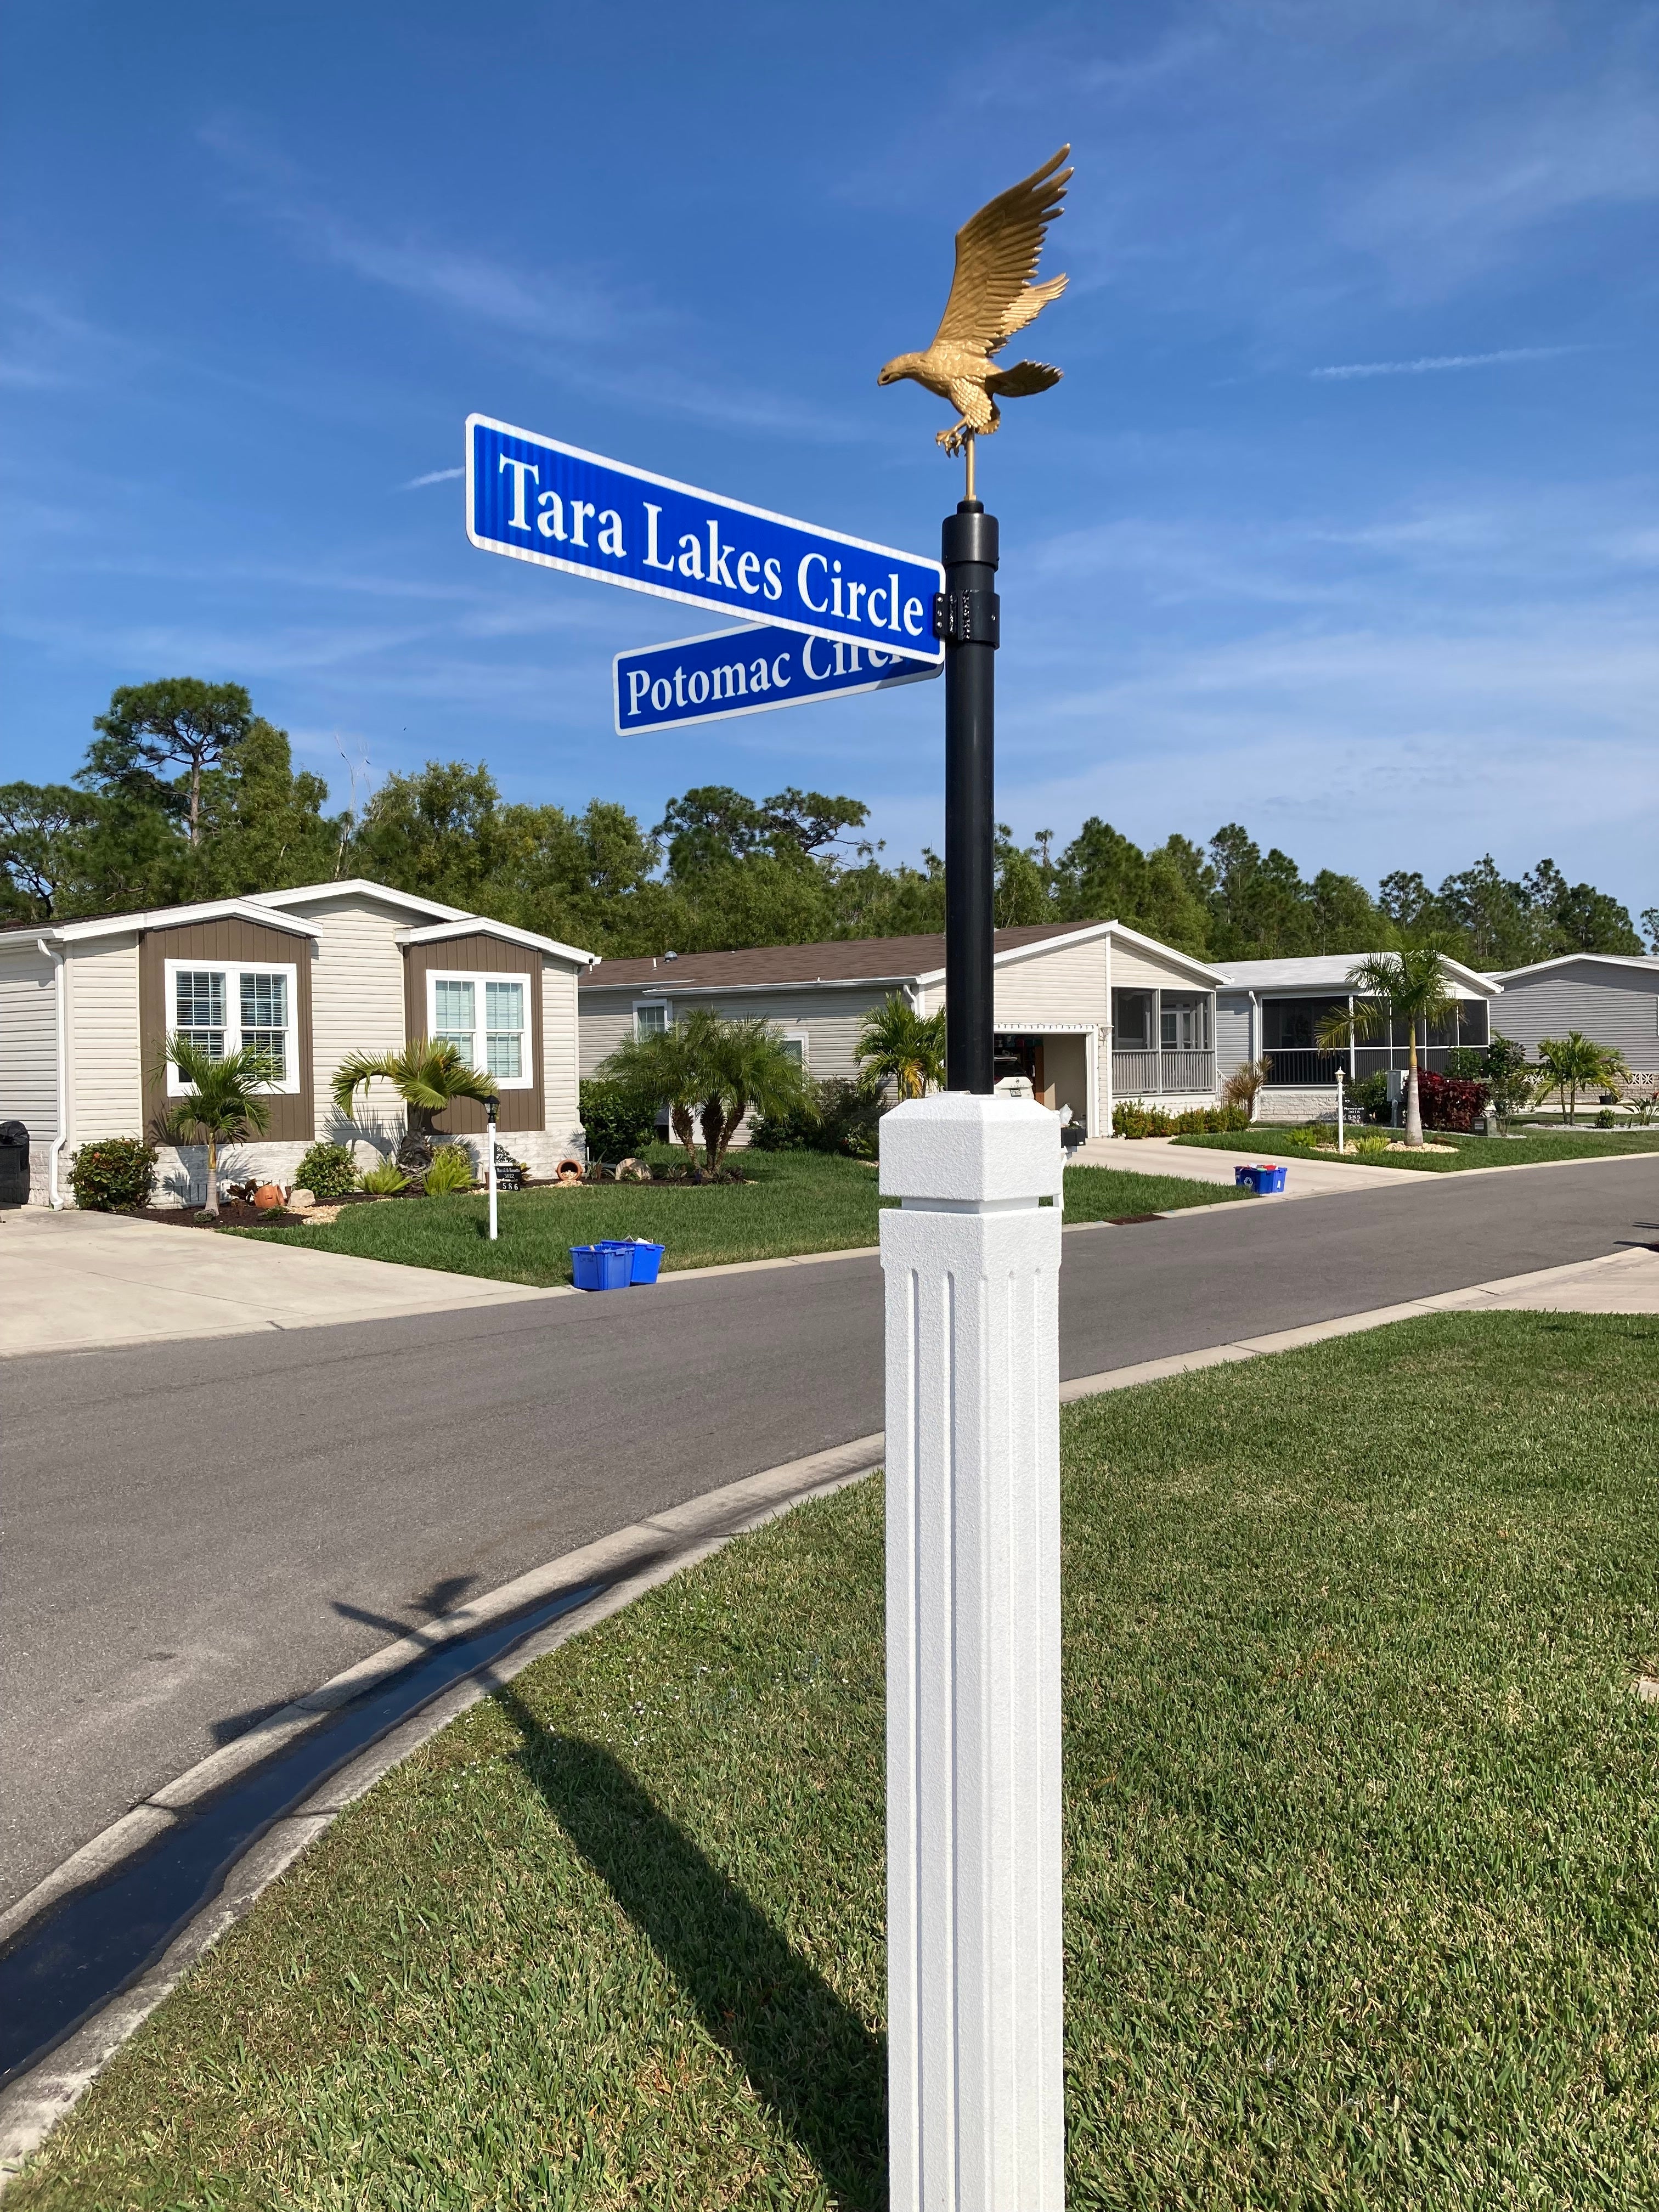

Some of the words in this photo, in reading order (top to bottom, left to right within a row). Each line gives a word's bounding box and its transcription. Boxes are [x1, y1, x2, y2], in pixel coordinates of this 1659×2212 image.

[498, 453, 627, 558] Tara
[642, 501, 783, 601] Lakes
[797, 553, 924, 637] Circle
[627, 652, 792, 716] Potomac
